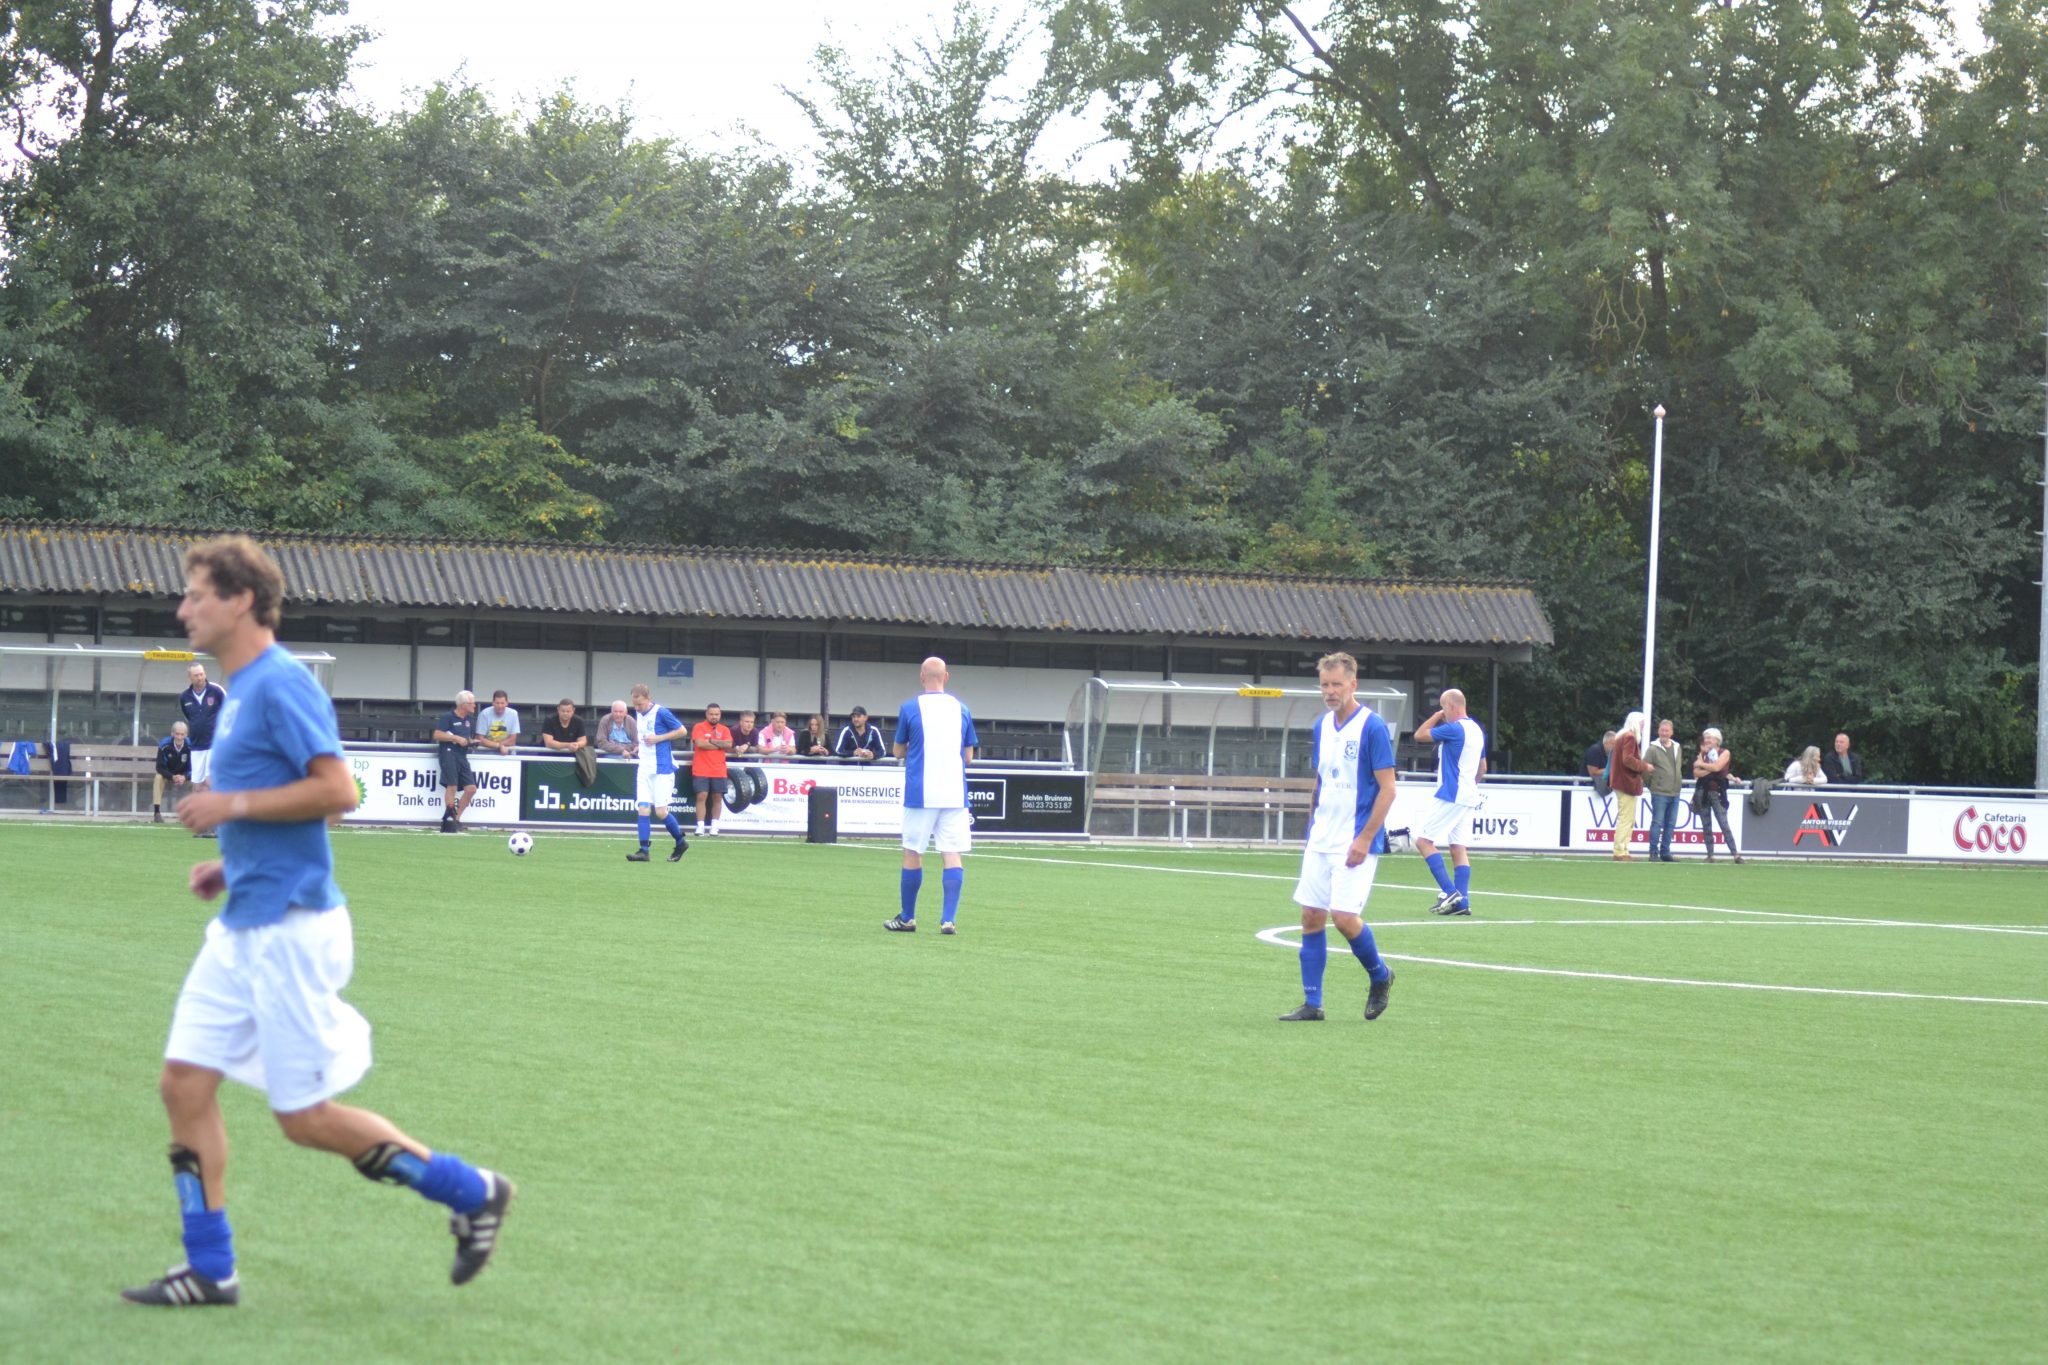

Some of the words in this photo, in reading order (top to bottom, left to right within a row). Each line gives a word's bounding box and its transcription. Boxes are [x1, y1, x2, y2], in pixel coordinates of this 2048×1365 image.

[353, 758, 370, 771] bp
[381, 769, 407, 787] BP
[413, 769, 437, 792] bij
[472, 771, 512, 794] Weg
[838, 786, 901, 798] DENSERVICE
[397, 794, 424, 807] Tank
[427, 797, 442, 807] en
[1021, 801, 1035, 809] (06)
[1984, 813, 2027, 823] Cafetaria
